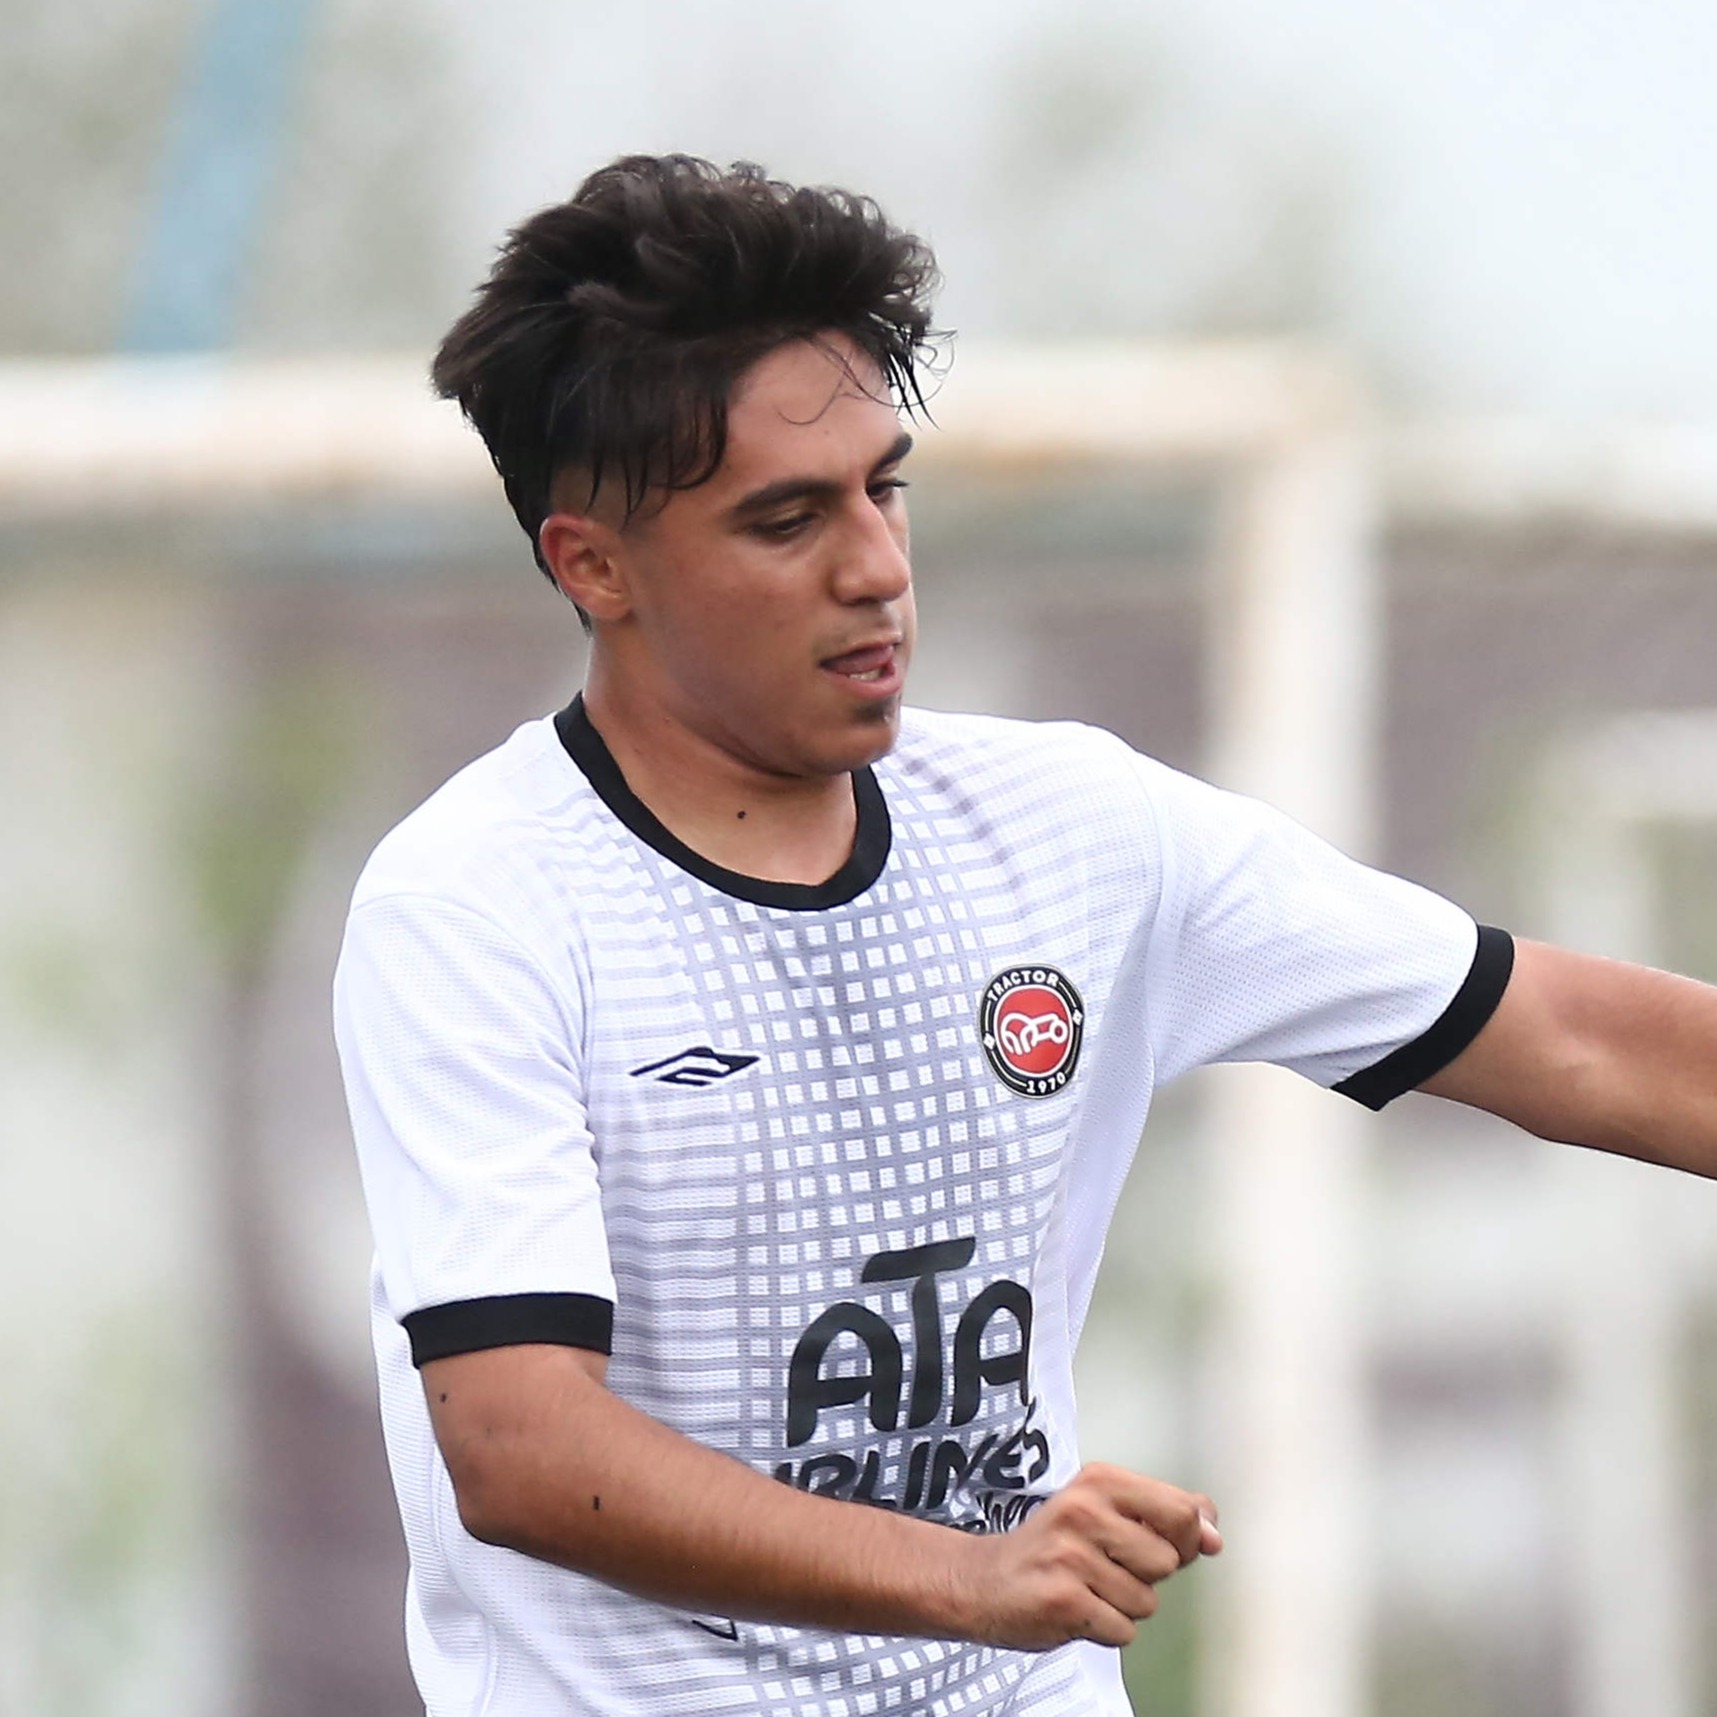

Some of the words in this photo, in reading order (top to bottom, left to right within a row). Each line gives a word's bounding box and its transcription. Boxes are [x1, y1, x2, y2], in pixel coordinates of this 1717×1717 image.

[987, 970, 1060, 1001] TRACTOR
[1026, 1072, 1066, 1094] 1970
[786, 1236, 1034, 1447] ATA
